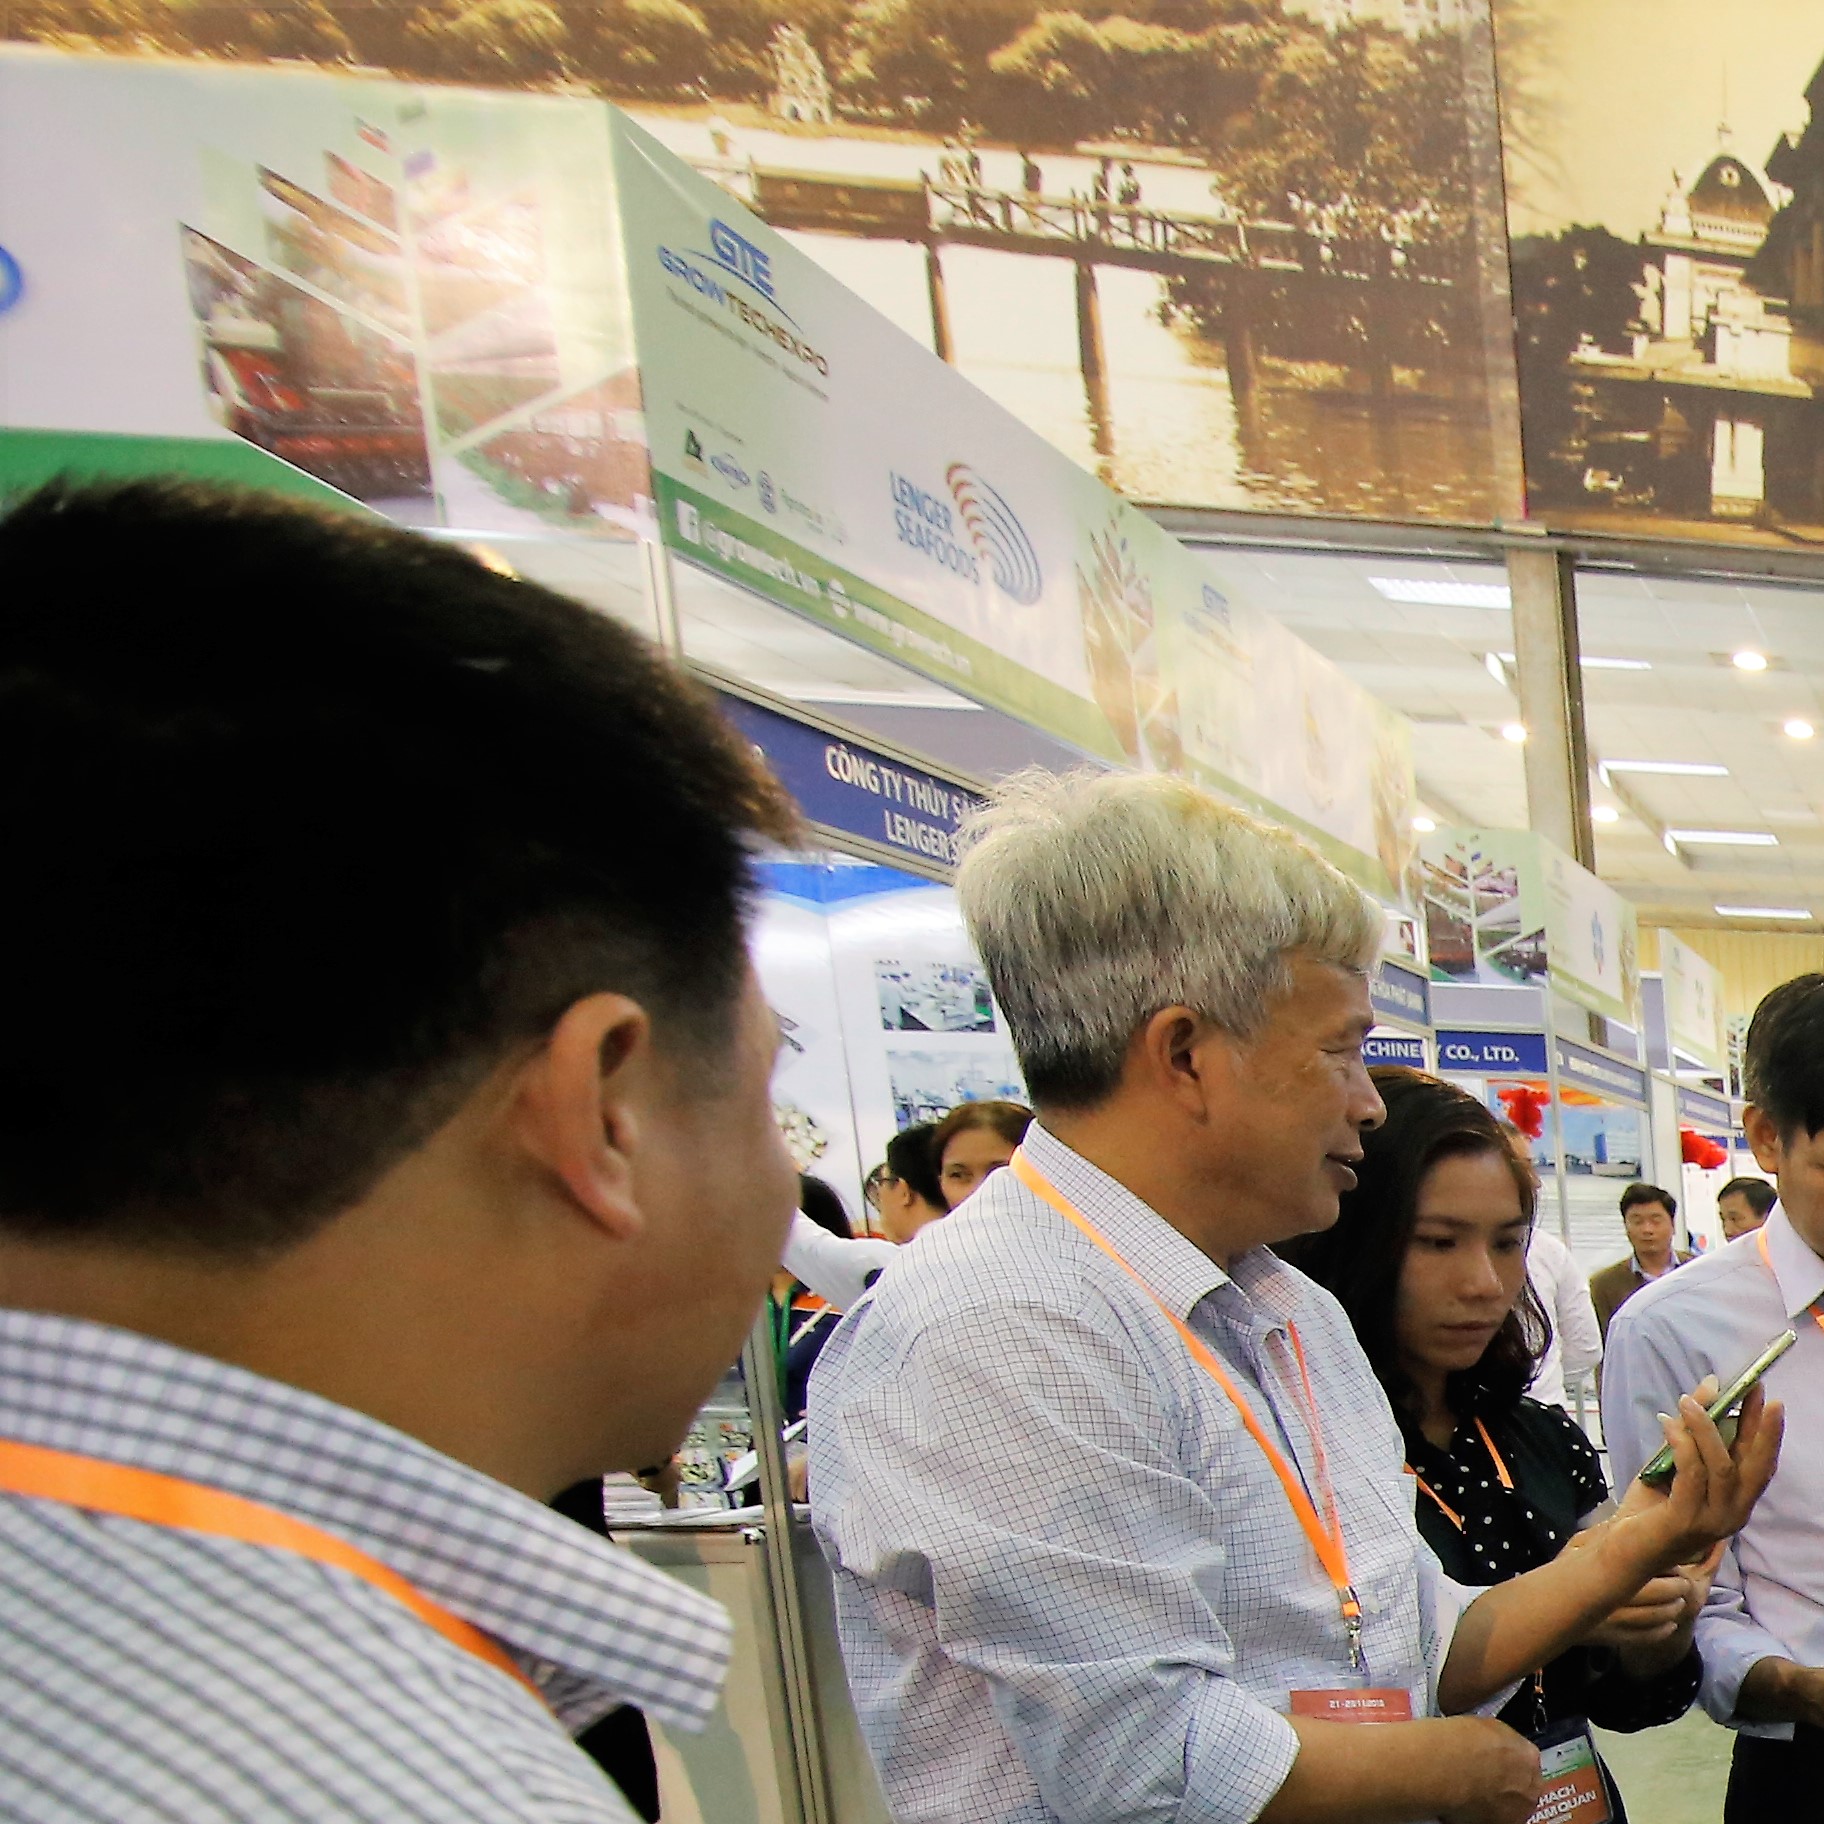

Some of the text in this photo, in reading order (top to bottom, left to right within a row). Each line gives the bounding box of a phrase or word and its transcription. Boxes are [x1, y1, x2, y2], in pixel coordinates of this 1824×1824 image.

[825, 743, 880, 794] CÔNG
[880, 766, 904, 802] TY
[1446, 1044, 1480, 1063] CO.,
[1483, 1046, 1520, 1063] LTD.
